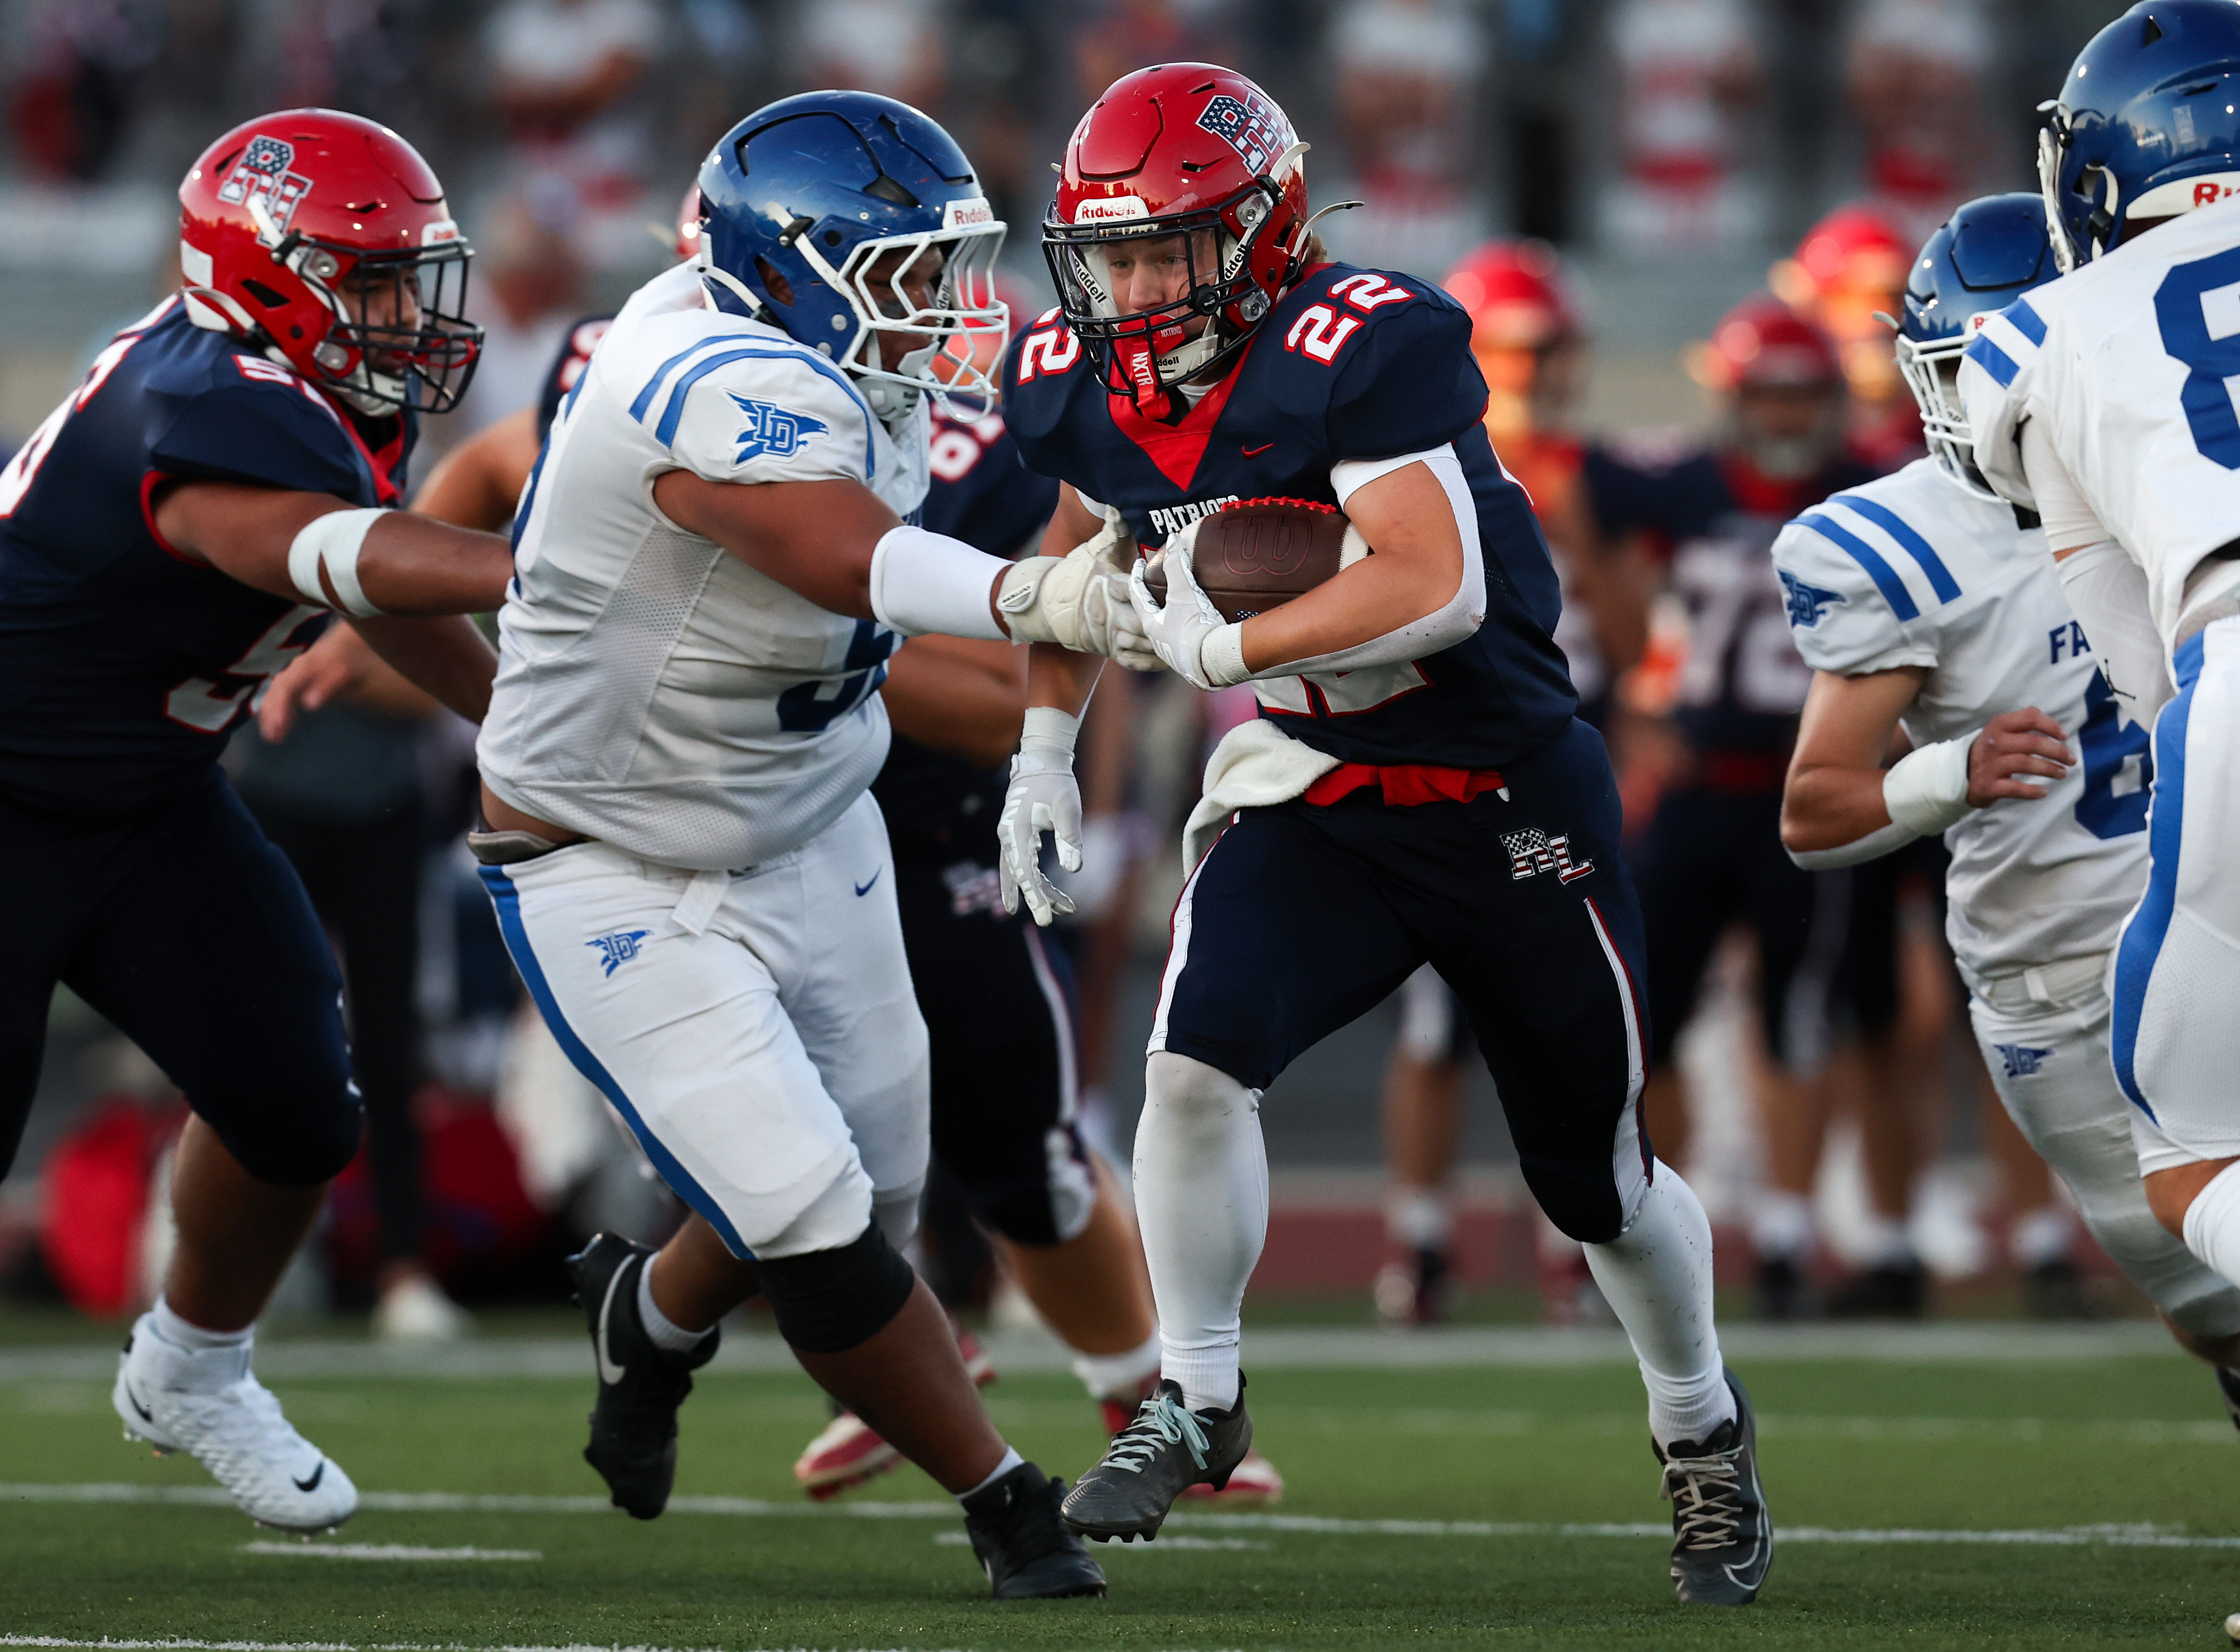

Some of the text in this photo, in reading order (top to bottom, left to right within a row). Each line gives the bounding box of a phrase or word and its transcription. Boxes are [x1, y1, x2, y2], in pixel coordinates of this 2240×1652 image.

[1225, 244, 1246, 279] ddell
[1160, 326, 1183, 338] NXTRND
[1284, 274, 1417, 367] 22
[1157, 356, 1179, 366] ddell
[750, 400, 798, 456] LD
